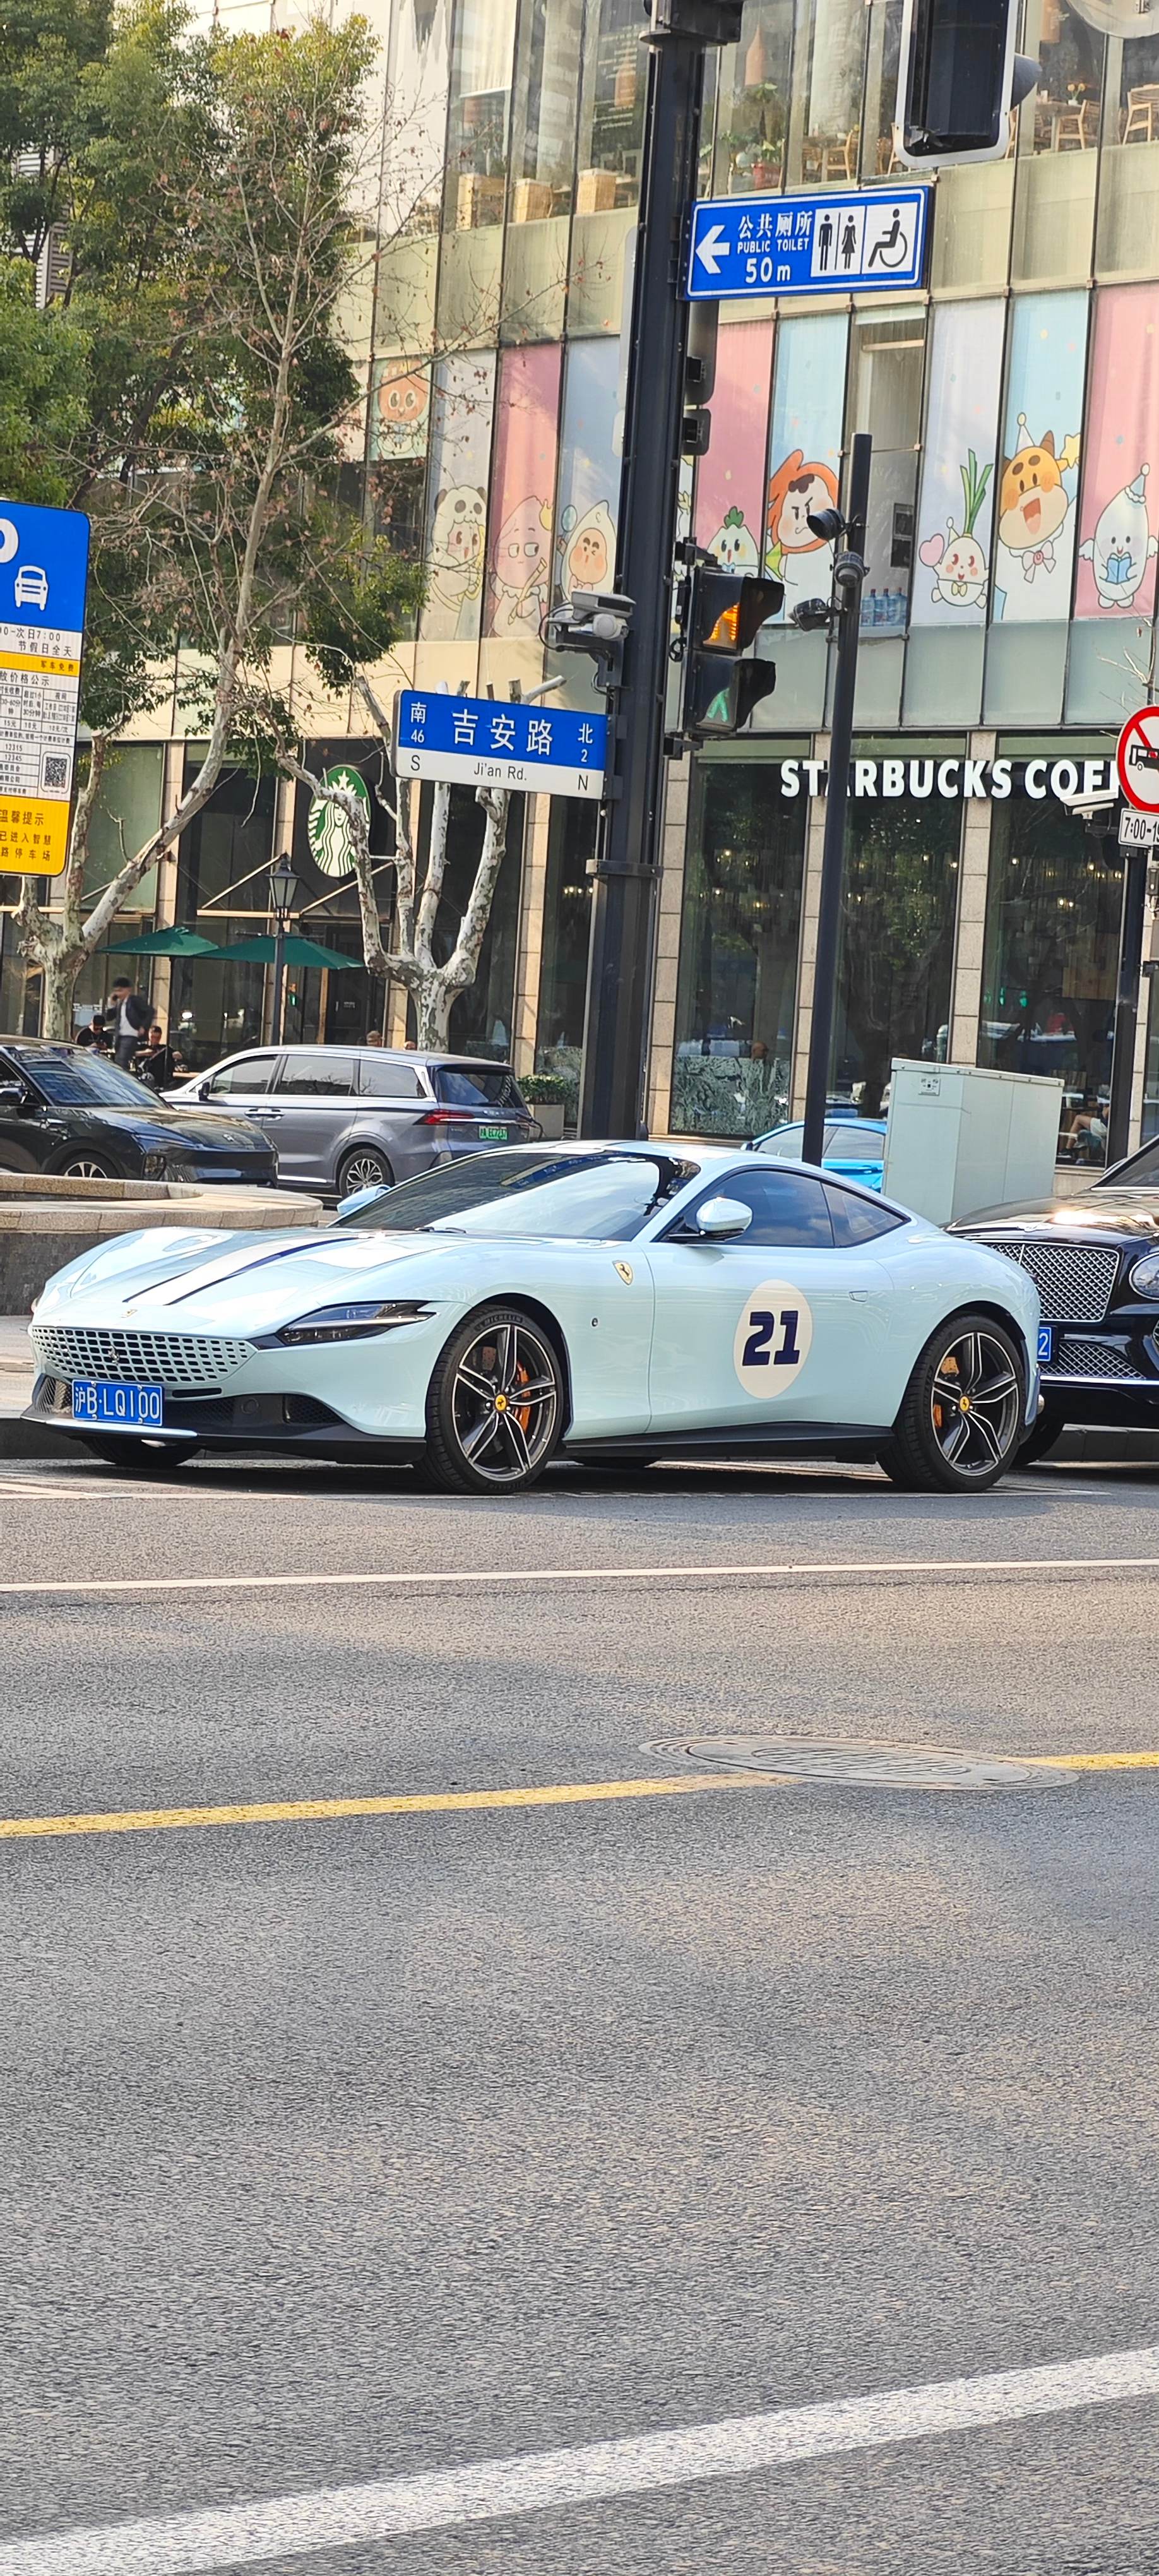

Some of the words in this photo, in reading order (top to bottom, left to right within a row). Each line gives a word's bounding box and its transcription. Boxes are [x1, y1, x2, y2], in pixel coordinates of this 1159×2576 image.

[737, 211, 813, 239] 公共厕所
[737, 240, 770, 254] PUBLIC
[777, 238, 809, 251] TOILET
[0, 626, 61, 641] 0-次日7:00
[18, 640, 71, 657] 节假日全天
[411, 702, 425, 724] 南
[411, 729, 425, 744] 46
[452, 708, 553, 756] 吉安路
[578, 723, 593, 744] 北
[411, 755, 420, 771] S
[581, 749, 587, 762] 2
[474, 763, 501, 778] Ji'an
[508, 766, 527, 781] Rd.
[781, 760, 1013, 799] STRBUCKS
[578, 775, 588, 790] N
[1, 847, 50, 861] 路停车场
[742, 1310, 800, 1366] 21
